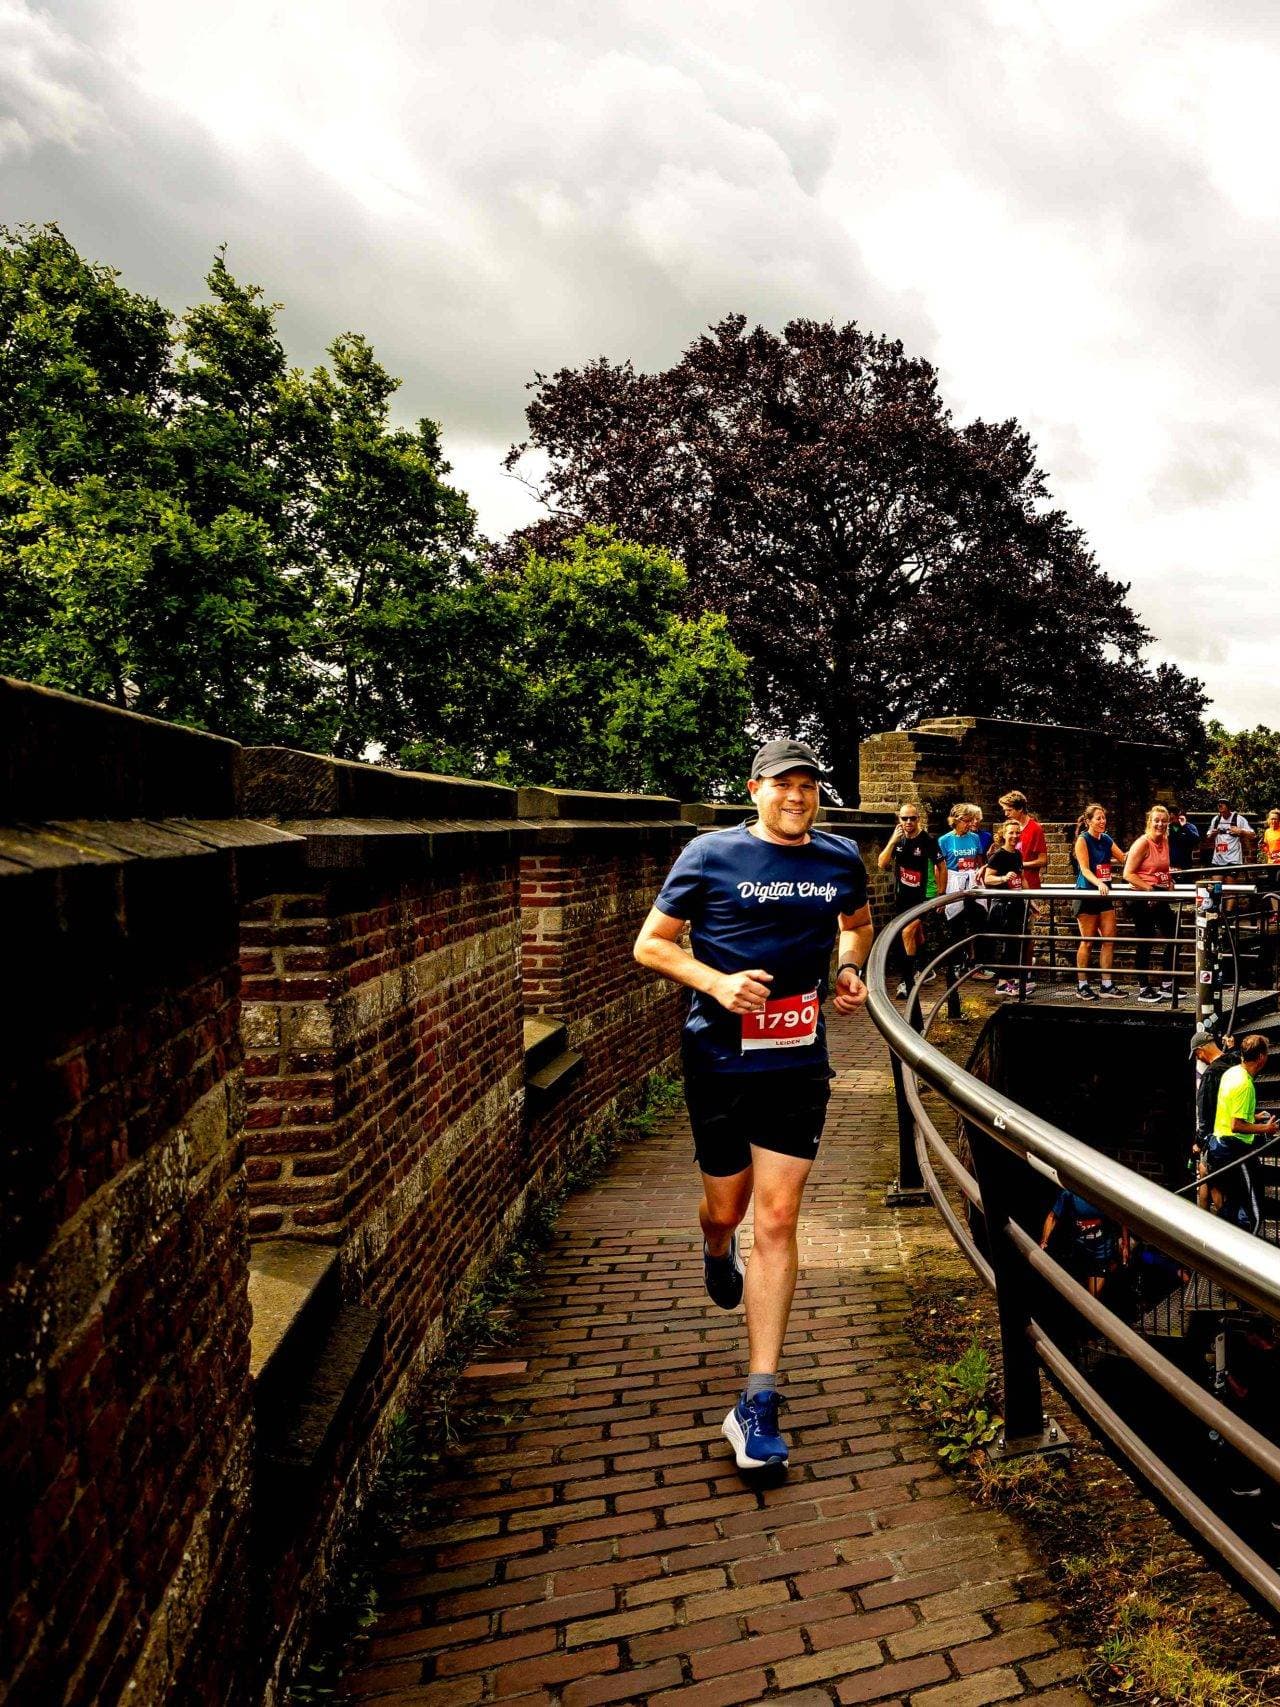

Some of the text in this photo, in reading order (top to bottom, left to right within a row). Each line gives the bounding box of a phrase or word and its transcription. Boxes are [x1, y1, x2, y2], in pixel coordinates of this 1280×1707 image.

[737, 881, 838, 903] Digital Chefs
[755, 1006, 815, 1030] 1790
